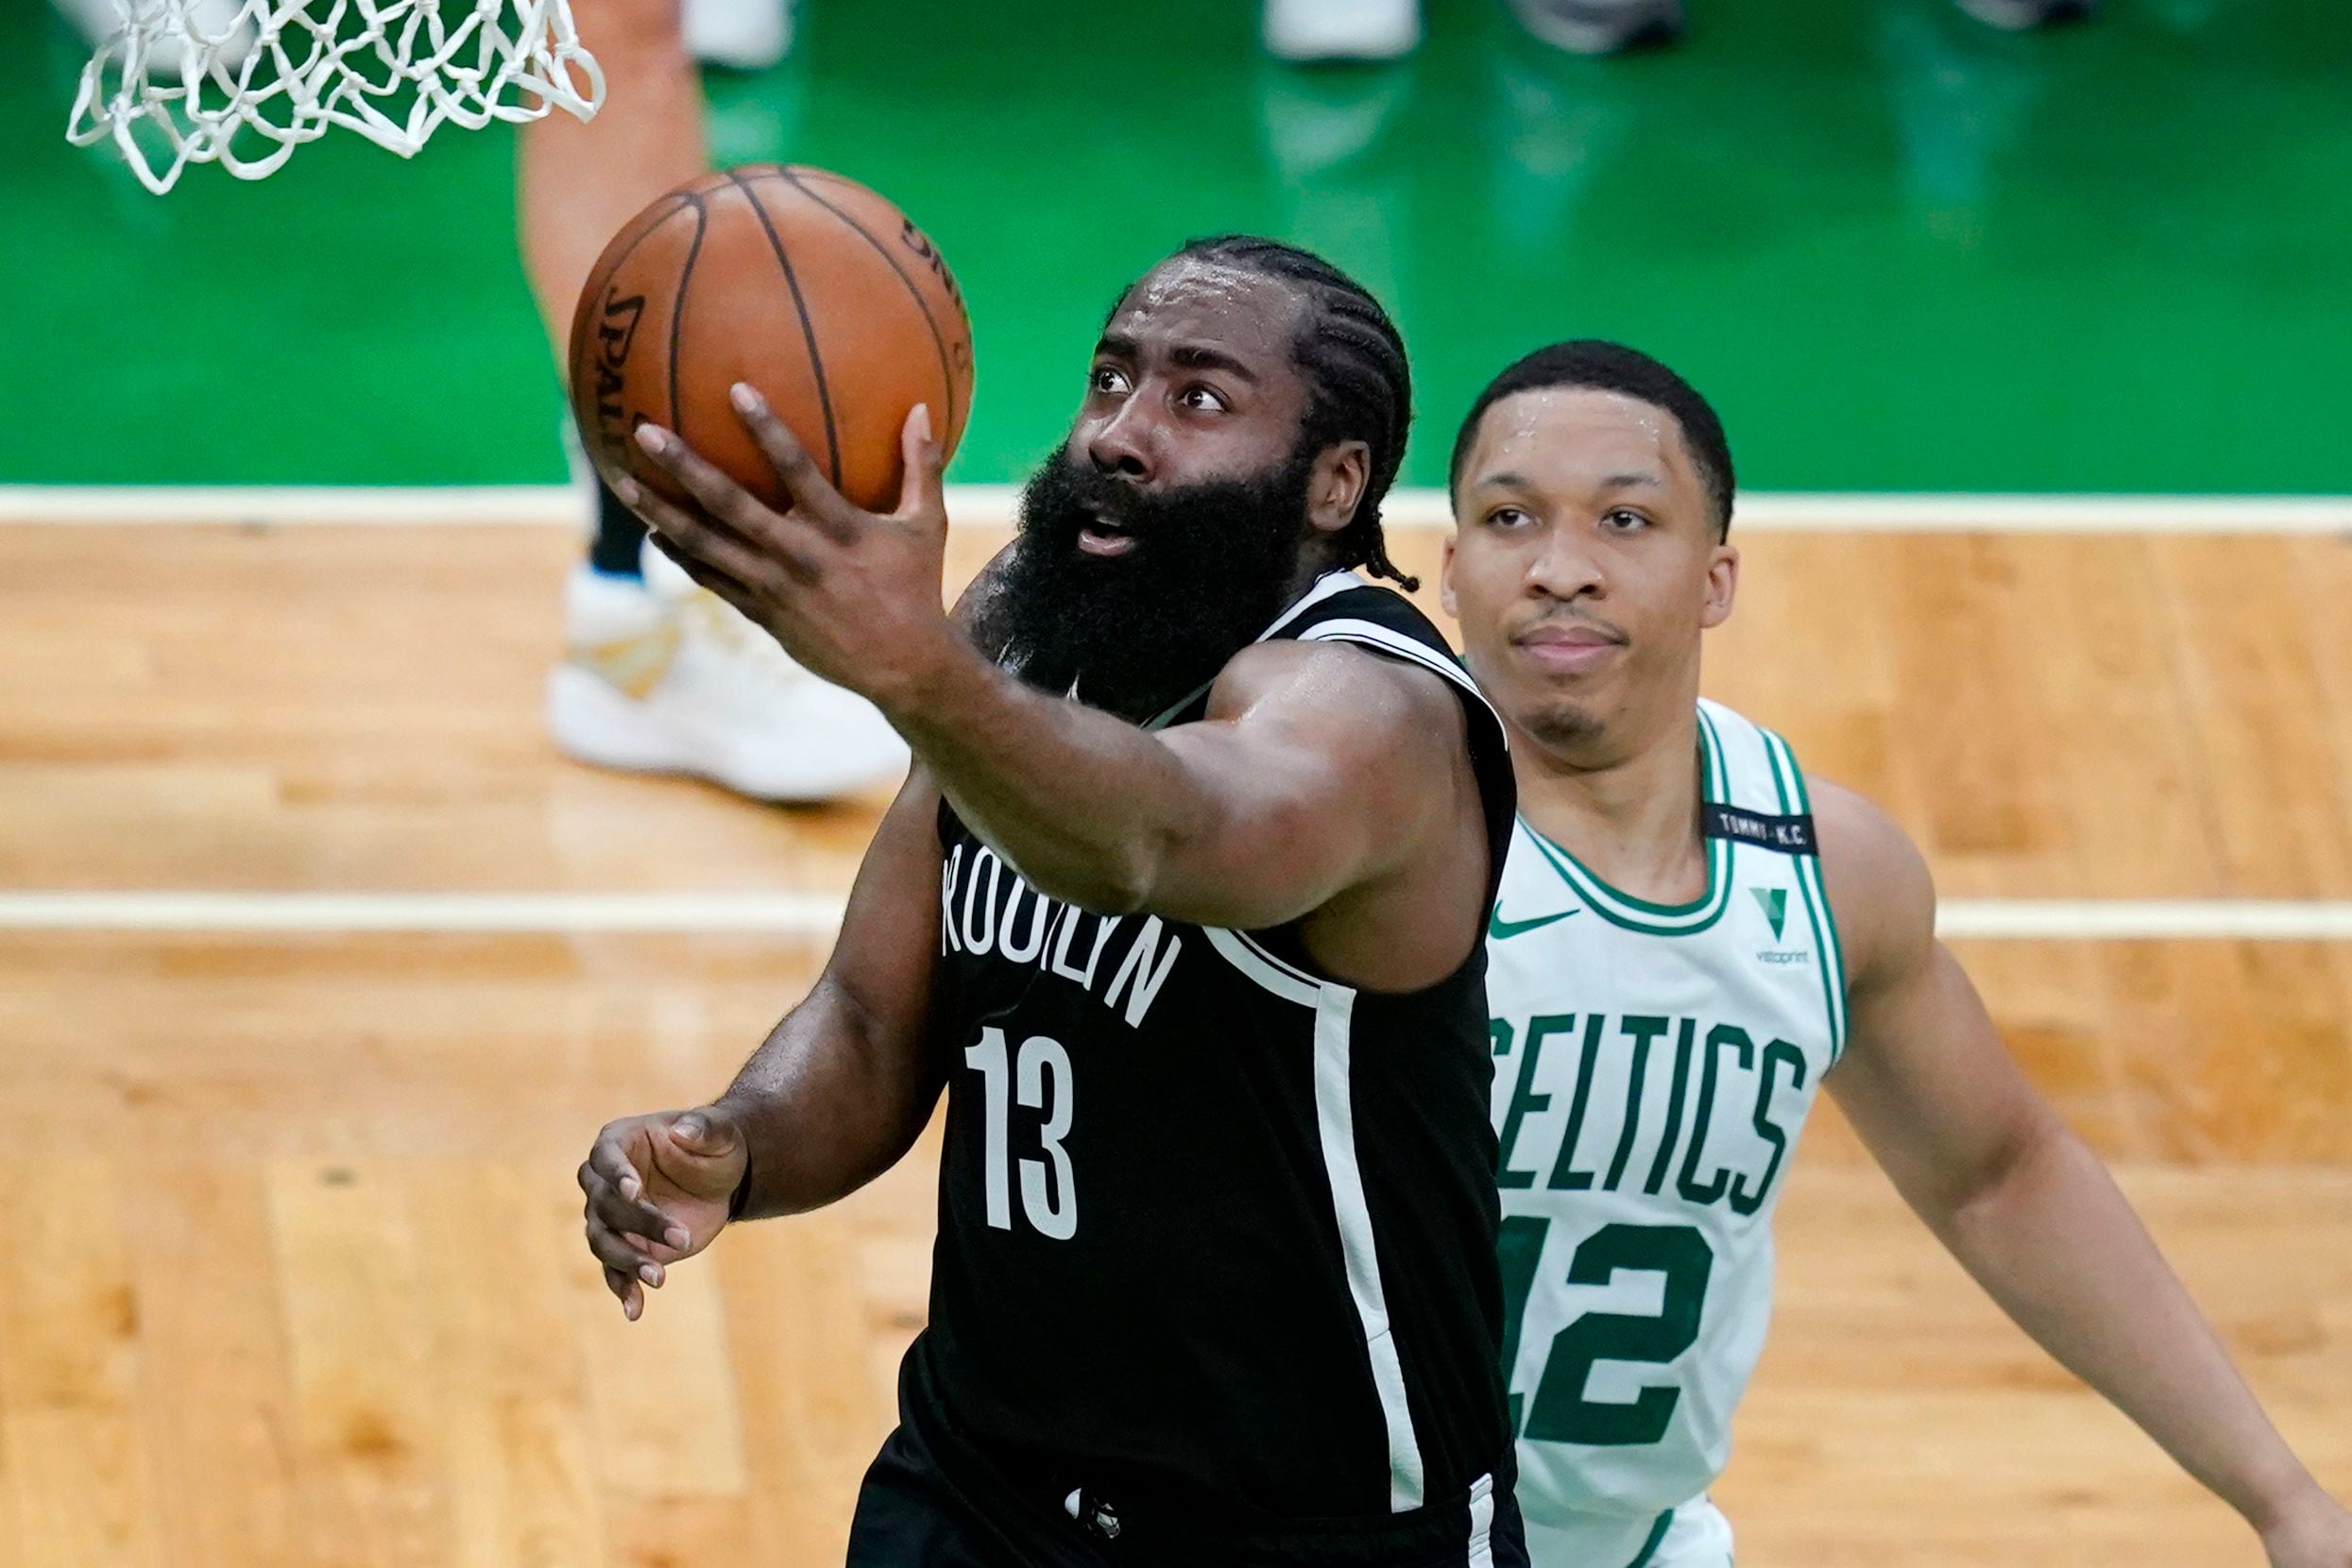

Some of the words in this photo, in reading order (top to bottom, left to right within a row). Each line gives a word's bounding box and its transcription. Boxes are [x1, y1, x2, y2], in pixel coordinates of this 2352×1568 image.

[1719, 813, 1768, 841] TOMMY
[1756, 949, 1810, 964] vistaprint
[963, 1025, 1078, 1241] 13
